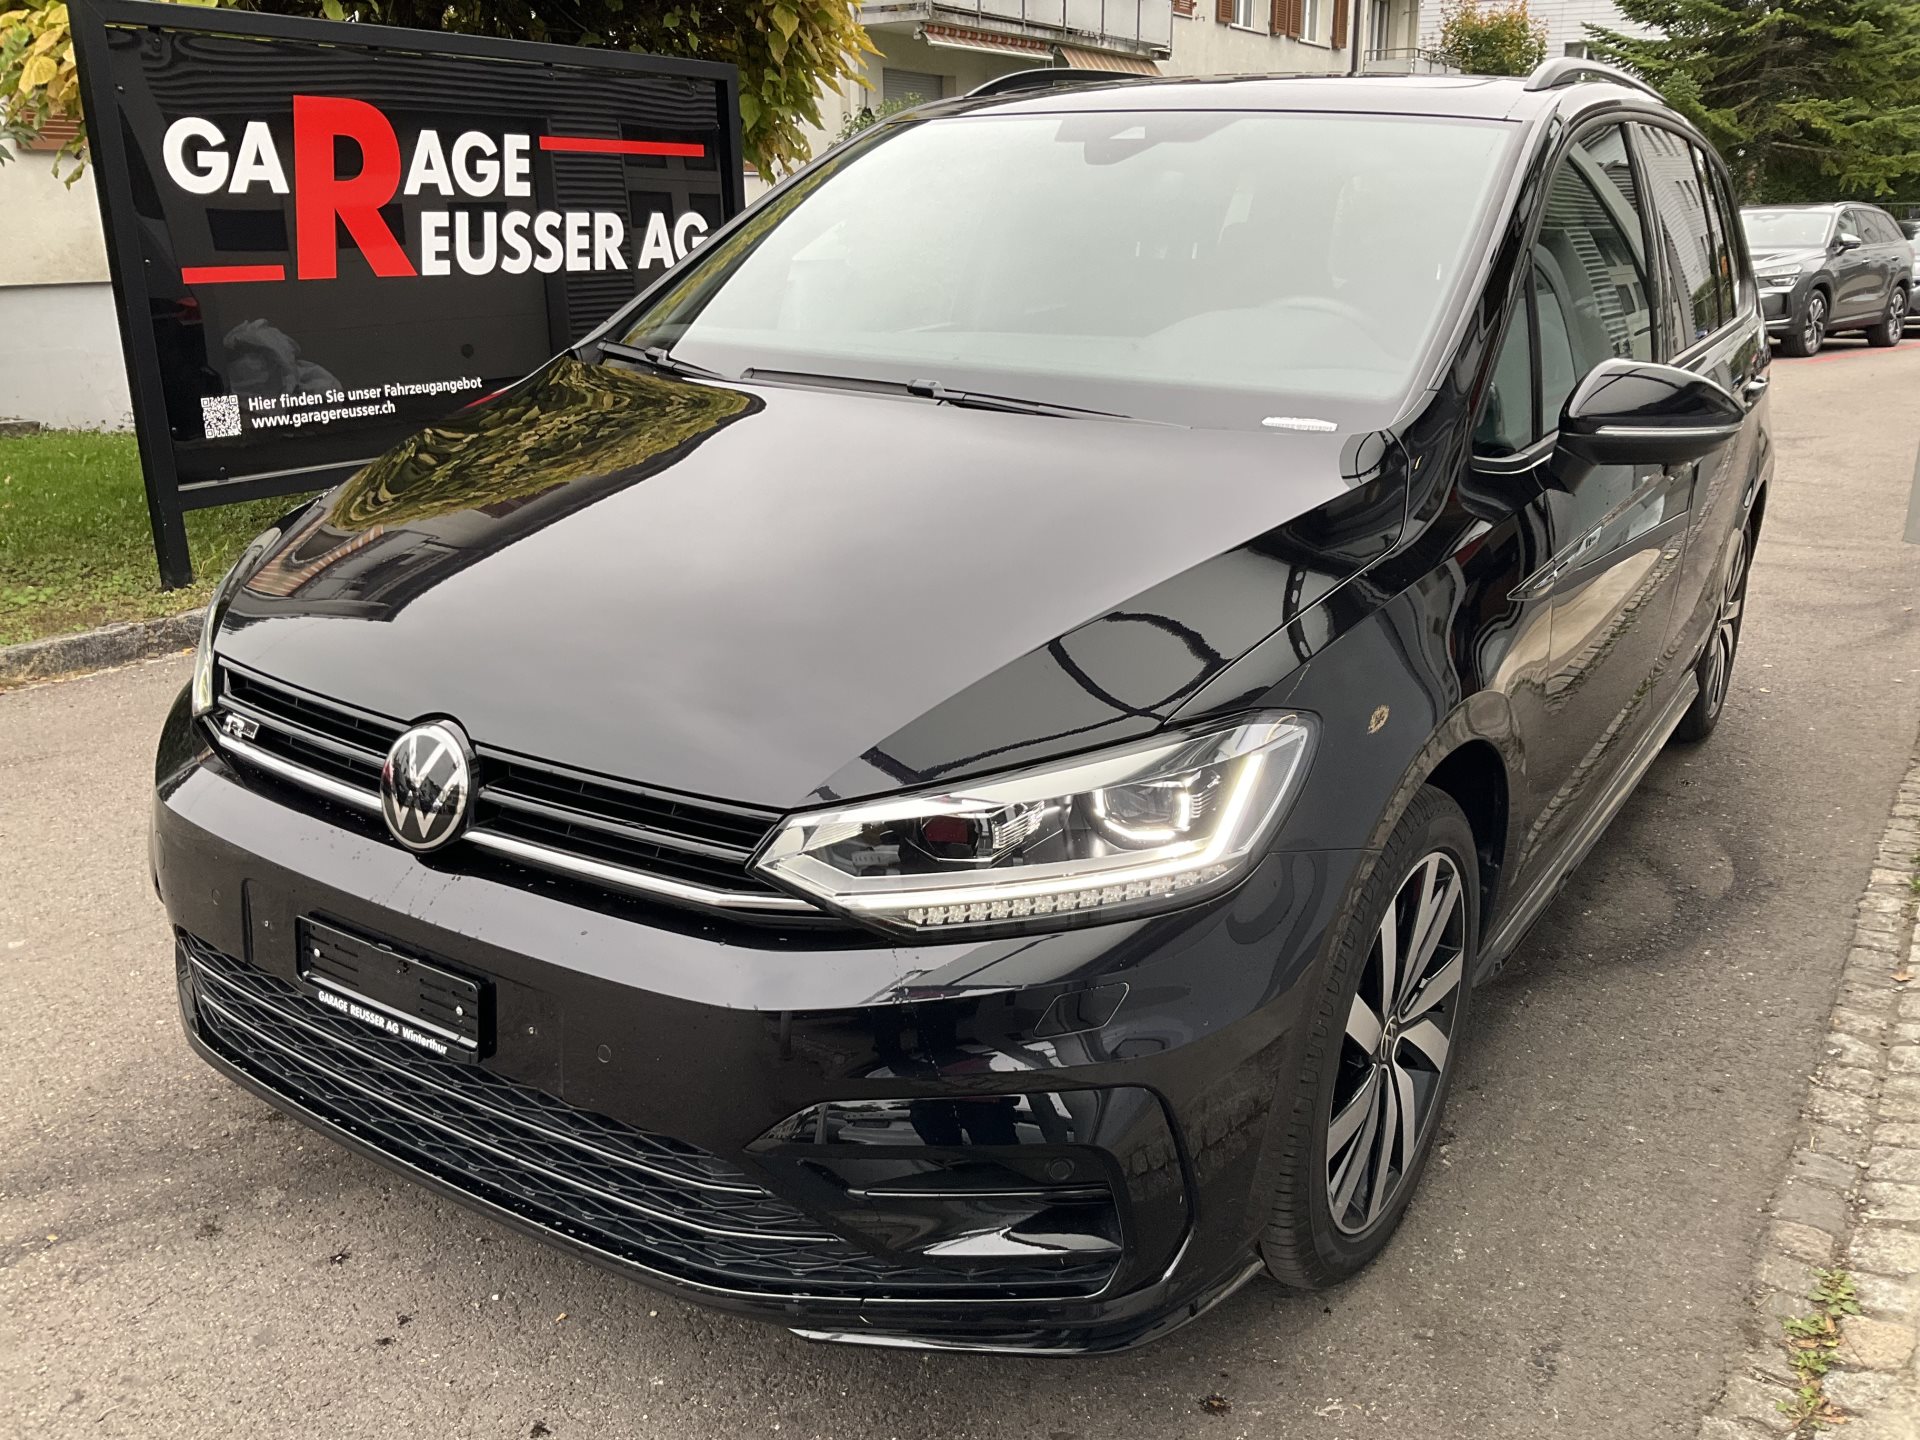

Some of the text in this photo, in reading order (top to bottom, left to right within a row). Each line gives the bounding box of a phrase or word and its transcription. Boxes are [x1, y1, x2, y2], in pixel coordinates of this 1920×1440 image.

[163, 95, 531, 280] GARAGE
[637, 212, 709, 270] AG
[248, 376, 483, 411] Hier finden Sie unser Fahrzeugangebot
[252, 401, 396, 428] www.garagereusser.ch
[318, 990, 448, 1055] GARAGE REUSSER AG Winterthur
